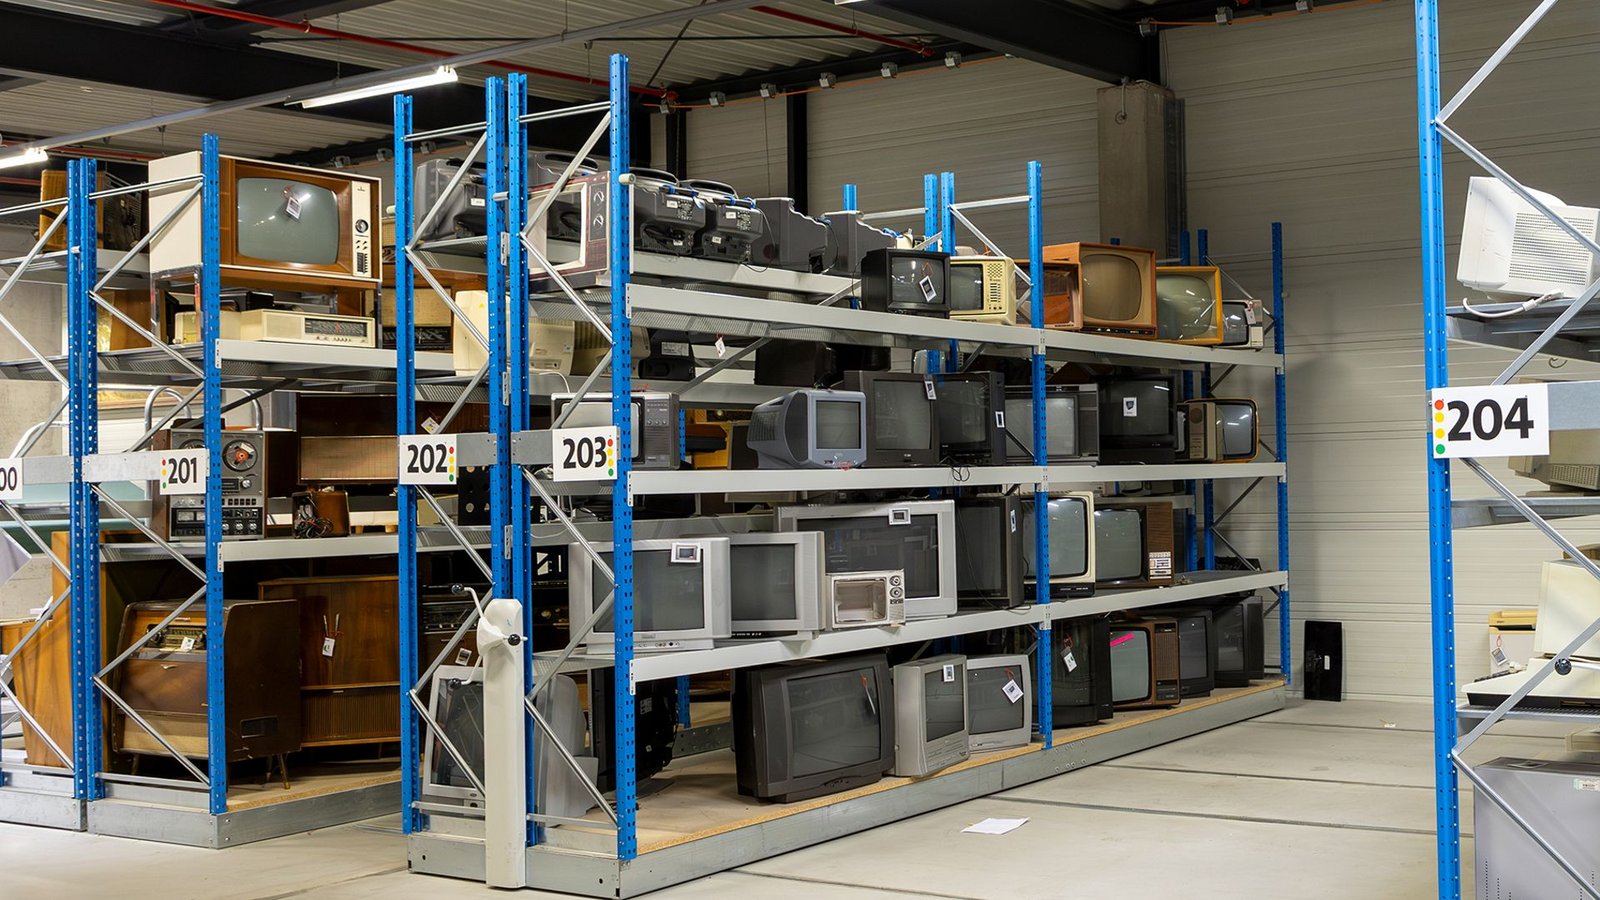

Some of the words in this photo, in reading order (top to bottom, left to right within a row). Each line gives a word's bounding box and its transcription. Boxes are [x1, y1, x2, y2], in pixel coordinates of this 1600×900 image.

[1447, 398, 1534, 441] 204
[407, 443, 447, 473] 202
[563, 436, 607, 469] 203
[168, 457, 197, 484] 201
